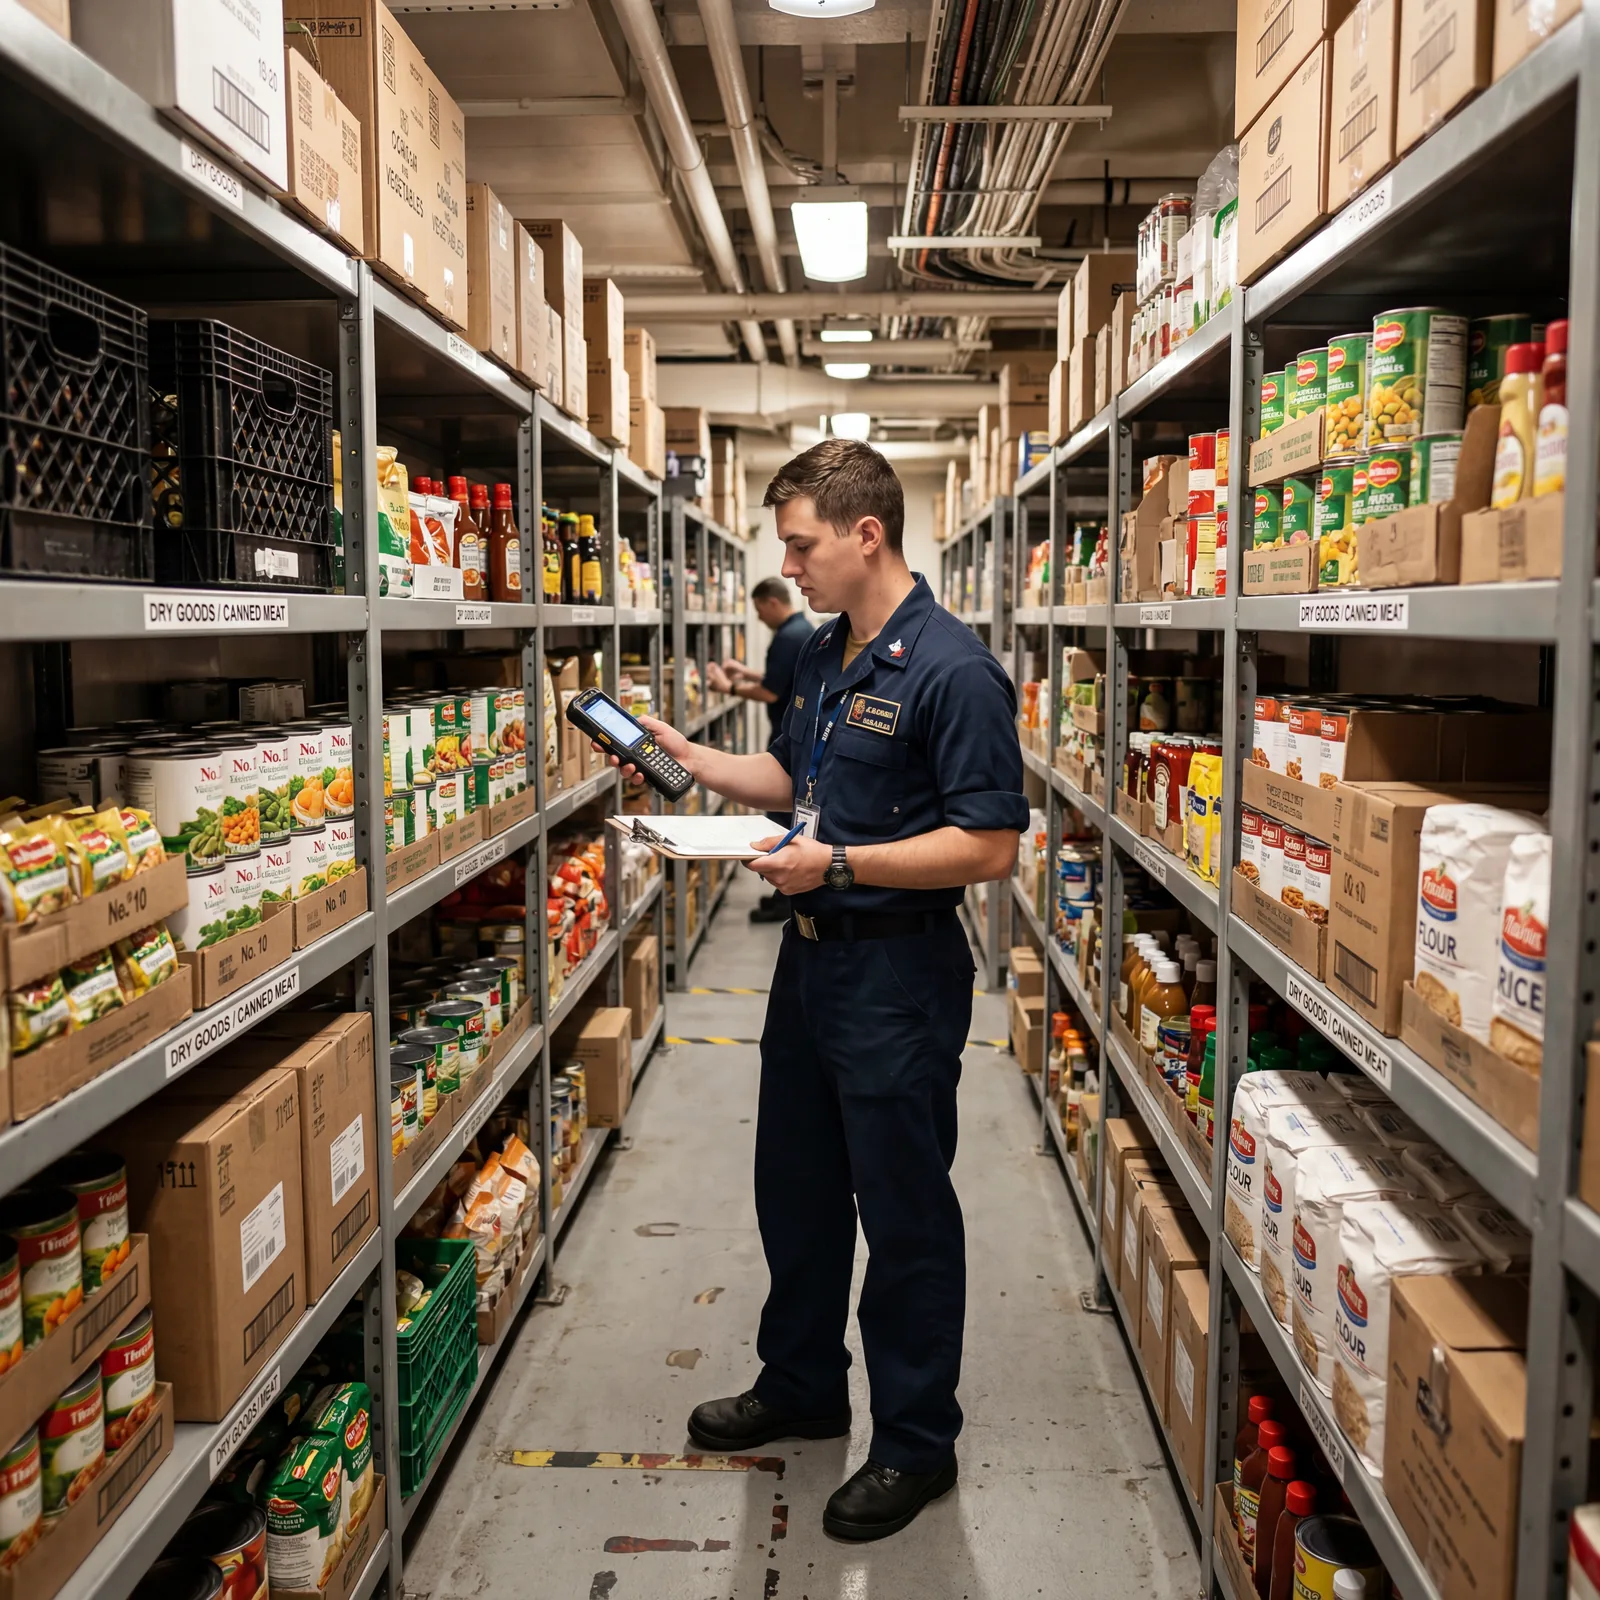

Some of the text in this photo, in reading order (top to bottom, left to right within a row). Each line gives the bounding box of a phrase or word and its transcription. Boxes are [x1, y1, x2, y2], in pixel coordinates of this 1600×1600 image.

[191, 151, 237, 197] DRY GOODS
[150, 603, 173, 622] DRY
[177, 603, 215, 622] GOODS
[223, 605, 261, 621] CANNED
[263, 605, 285, 621] MEAT
[1301, 606, 1314, 621] DRY
[1344, 604, 1378, 621] CANNED
[1380, 603, 1404, 621] MEAT
[262, 750, 281, 763] No.
[339, 889, 347, 906] 10
[241, 934, 268, 964] No. 10
[1419, 921, 1457, 960] FLOUR
[1499, 966, 1543, 1014] RICE
[171, 1039, 192, 1068] DRY
[194, 1015, 231, 1051] GOODS
[237, 989, 273, 1023] CANNED
[274, 973, 296, 1000] MEAT
[1288, 980, 1303, 1003] DRY
[1303, 991, 1328, 1025] GOODS
[1332, 1017, 1364, 1057] CANNED
[1364, 1048, 1388, 1079] MEAT
[1335, 1309, 1366, 1362] FLOUR
[216, 1434, 231, 1466] DRY
[232, 1402, 257, 1443] GOODS
[260, 1374, 278, 1408] MEAT
